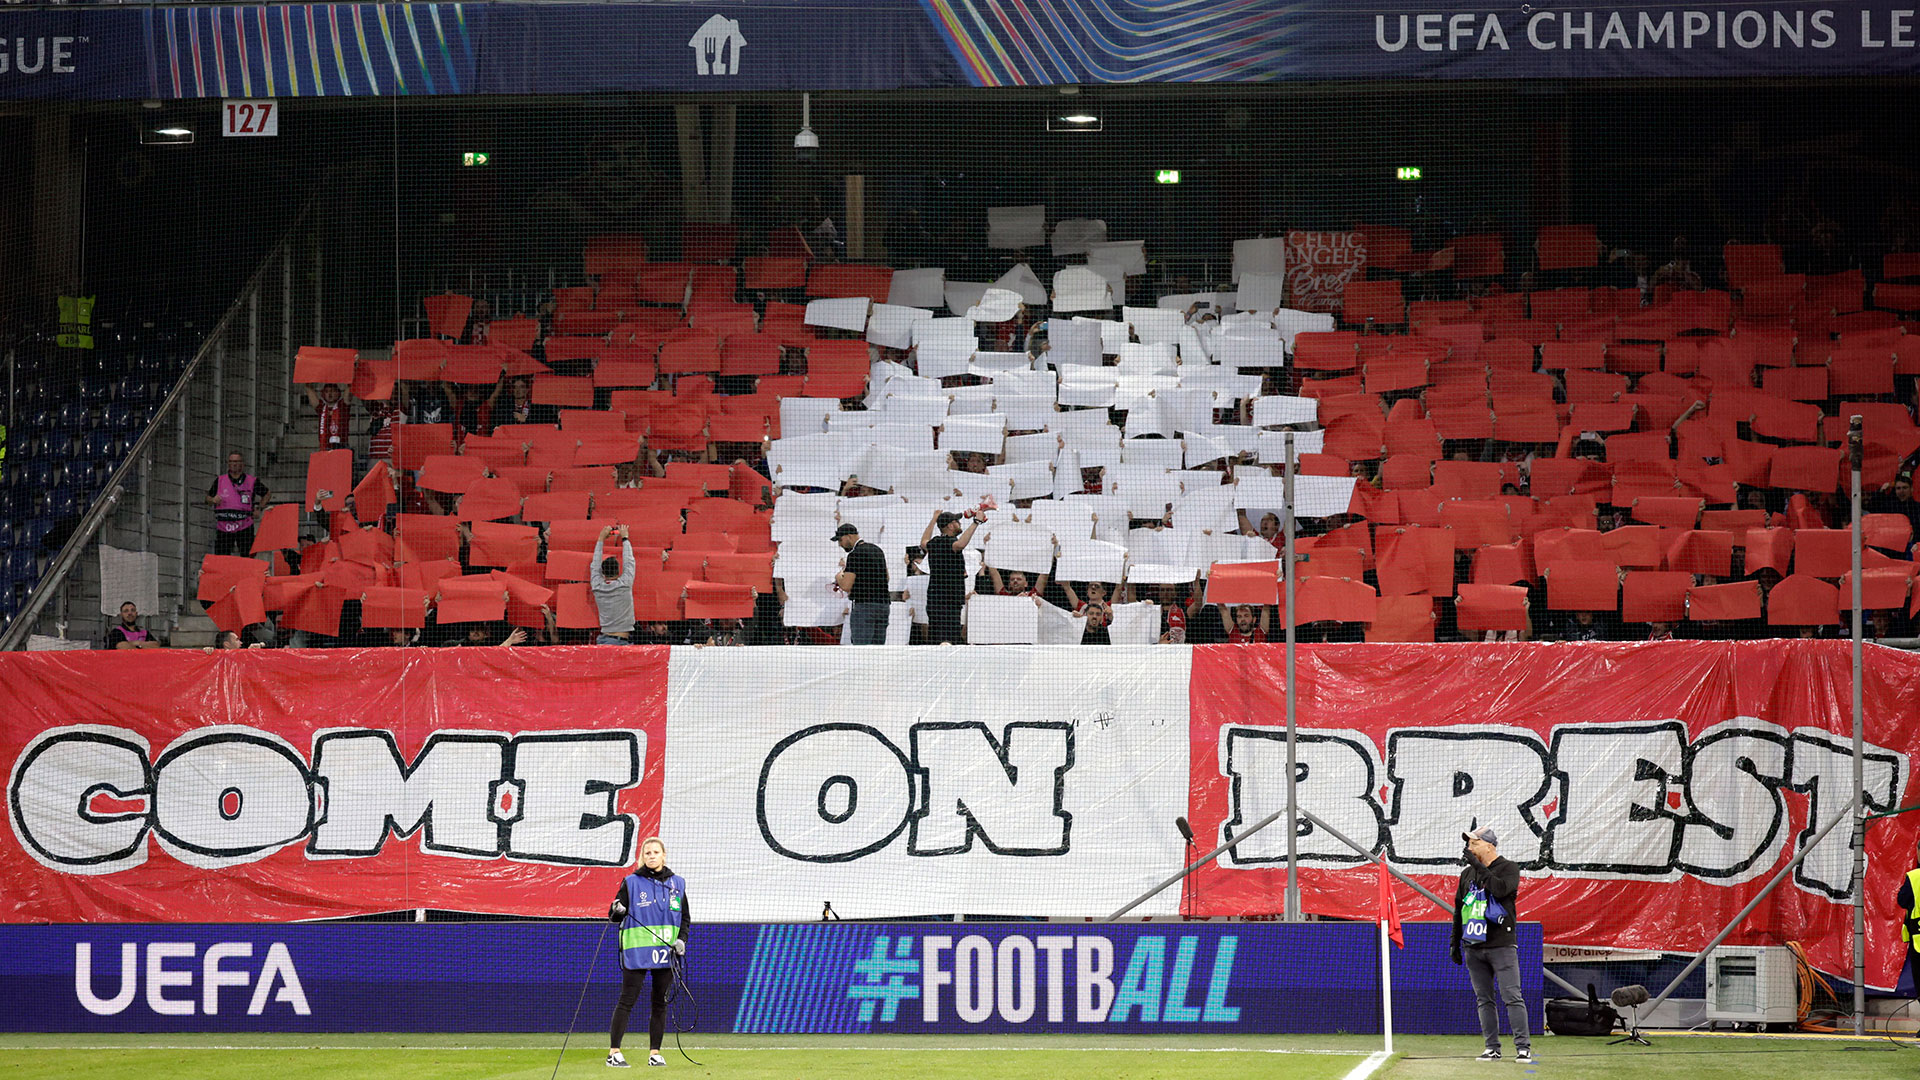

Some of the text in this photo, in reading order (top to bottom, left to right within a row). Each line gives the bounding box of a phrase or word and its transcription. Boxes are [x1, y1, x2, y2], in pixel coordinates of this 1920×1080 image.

[1375, 9, 1920, 52] UEFA CHAMPIONS LE
[226, 103, 273, 133] 127
[1284, 247, 1367, 265] ANGELS
[1288, 231, 1363, 249] CELTIC
[1287, 259, 1359, 295] Brest
[7, 725, 648, 875] COME
[756, 721, 1076, 863] ON
[1217, 716, 1909, 903] BREST
[652, 928, 673, 943] HB
[652, 949, 669, 964] 02
[75, 942, 312, 1016] UEFA
[846, 934, 1242, 1023] #FOOTBALL
